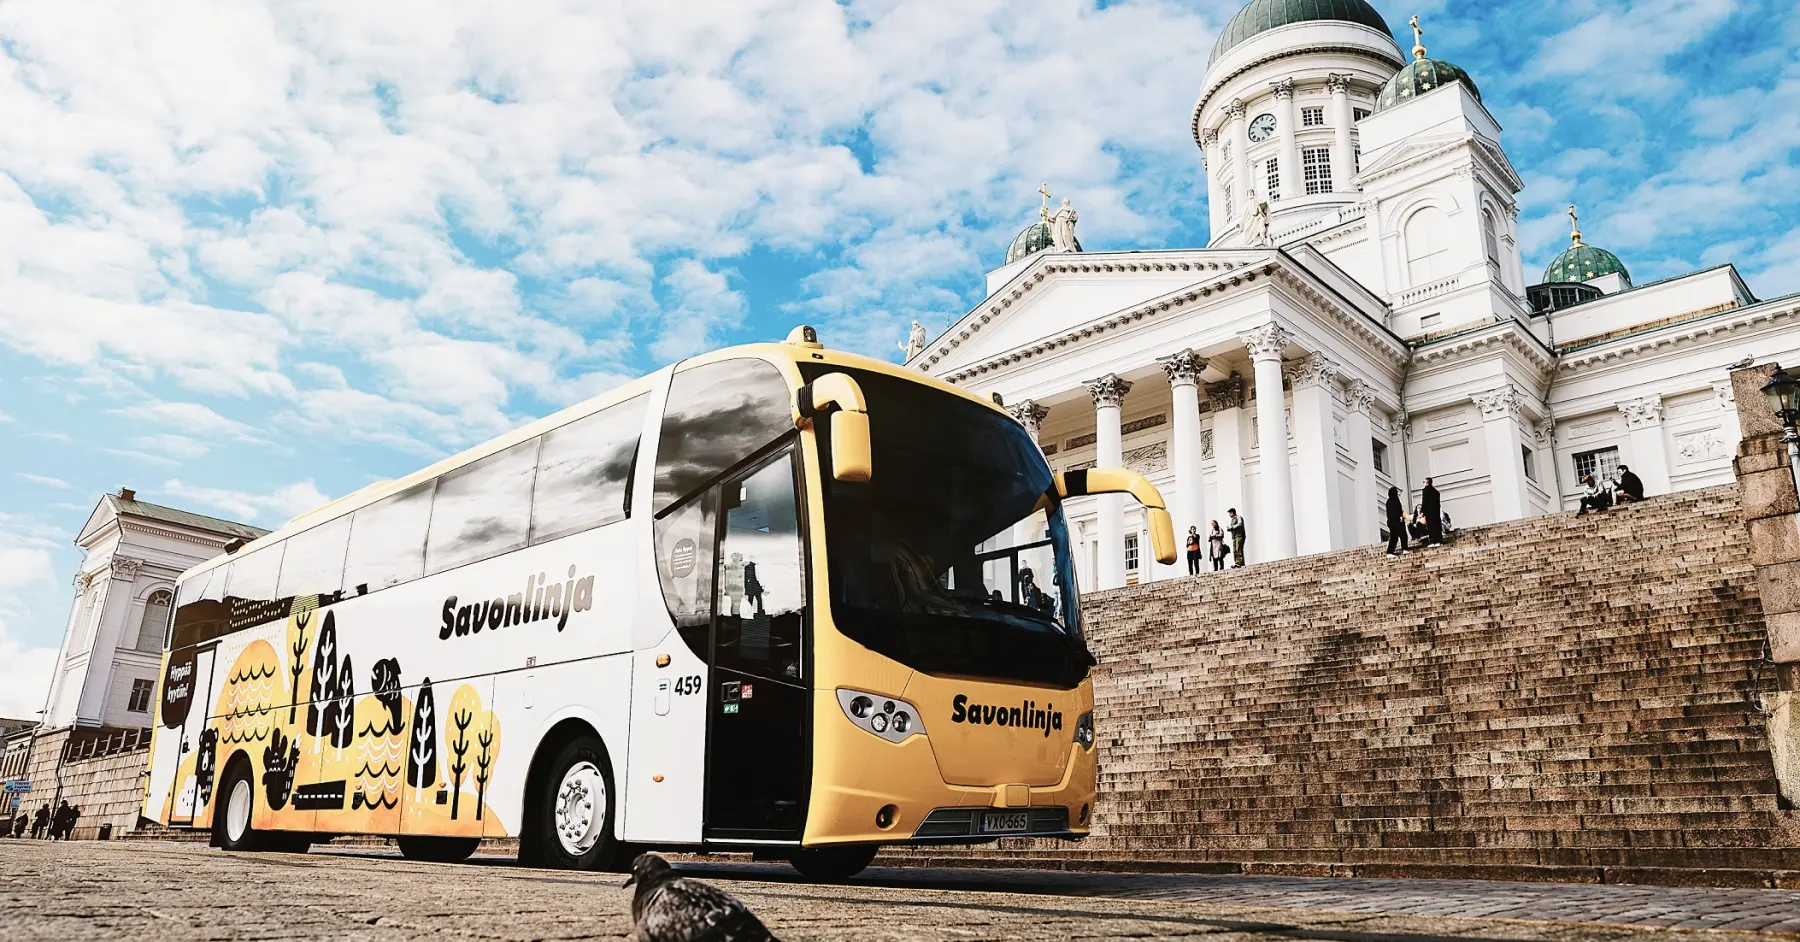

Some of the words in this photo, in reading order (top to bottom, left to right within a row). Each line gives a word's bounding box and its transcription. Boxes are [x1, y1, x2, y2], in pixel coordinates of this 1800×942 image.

[438, 564, 595, 640] Savonlinja
[170, 661, 192, 682] Hyppää
[674, 675, 702, 696] 459
[951, 693, 1063, 739] Savonlinja
